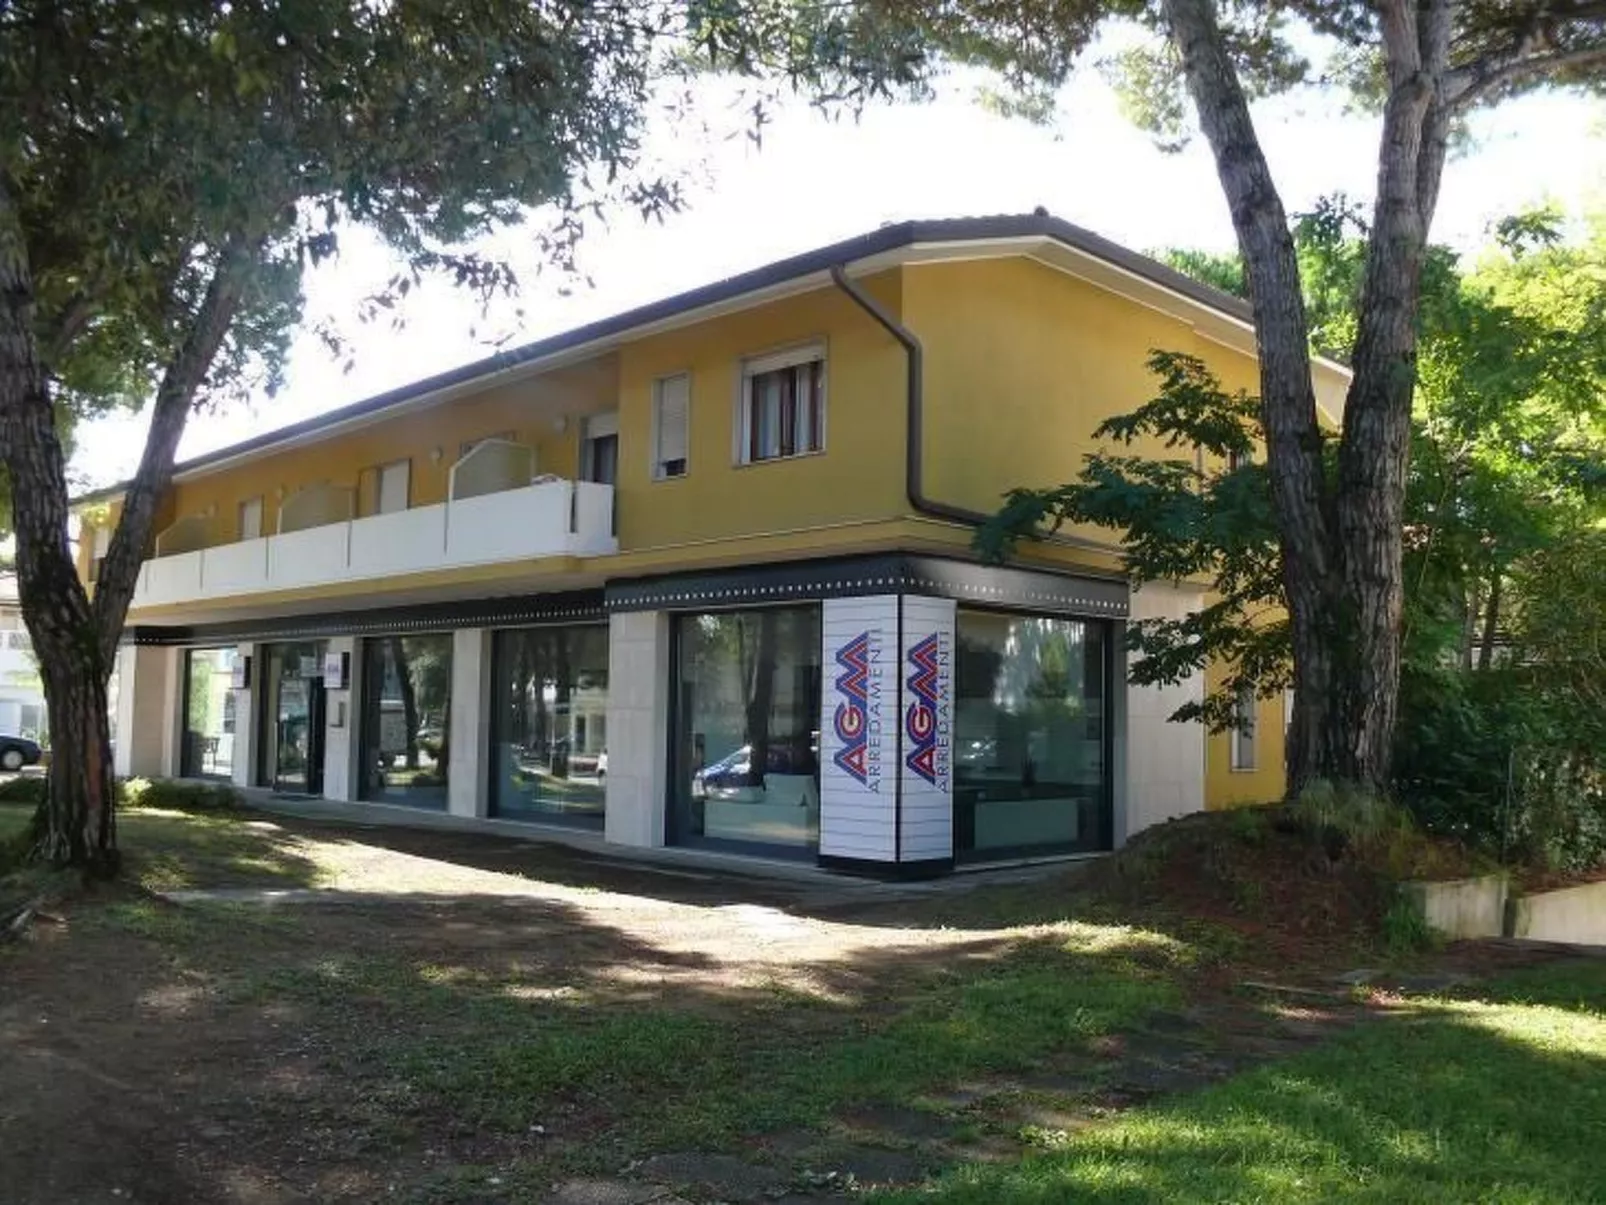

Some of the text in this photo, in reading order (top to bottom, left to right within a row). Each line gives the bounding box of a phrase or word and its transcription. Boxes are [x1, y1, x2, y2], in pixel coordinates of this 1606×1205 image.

[834, 630, 868, 785] AGM
[868, 628, 882, 794] ARREDAMENTI
[906, 631, 937, 785] AGM
[936, 631, 949, 794] ARREDAMENTI
